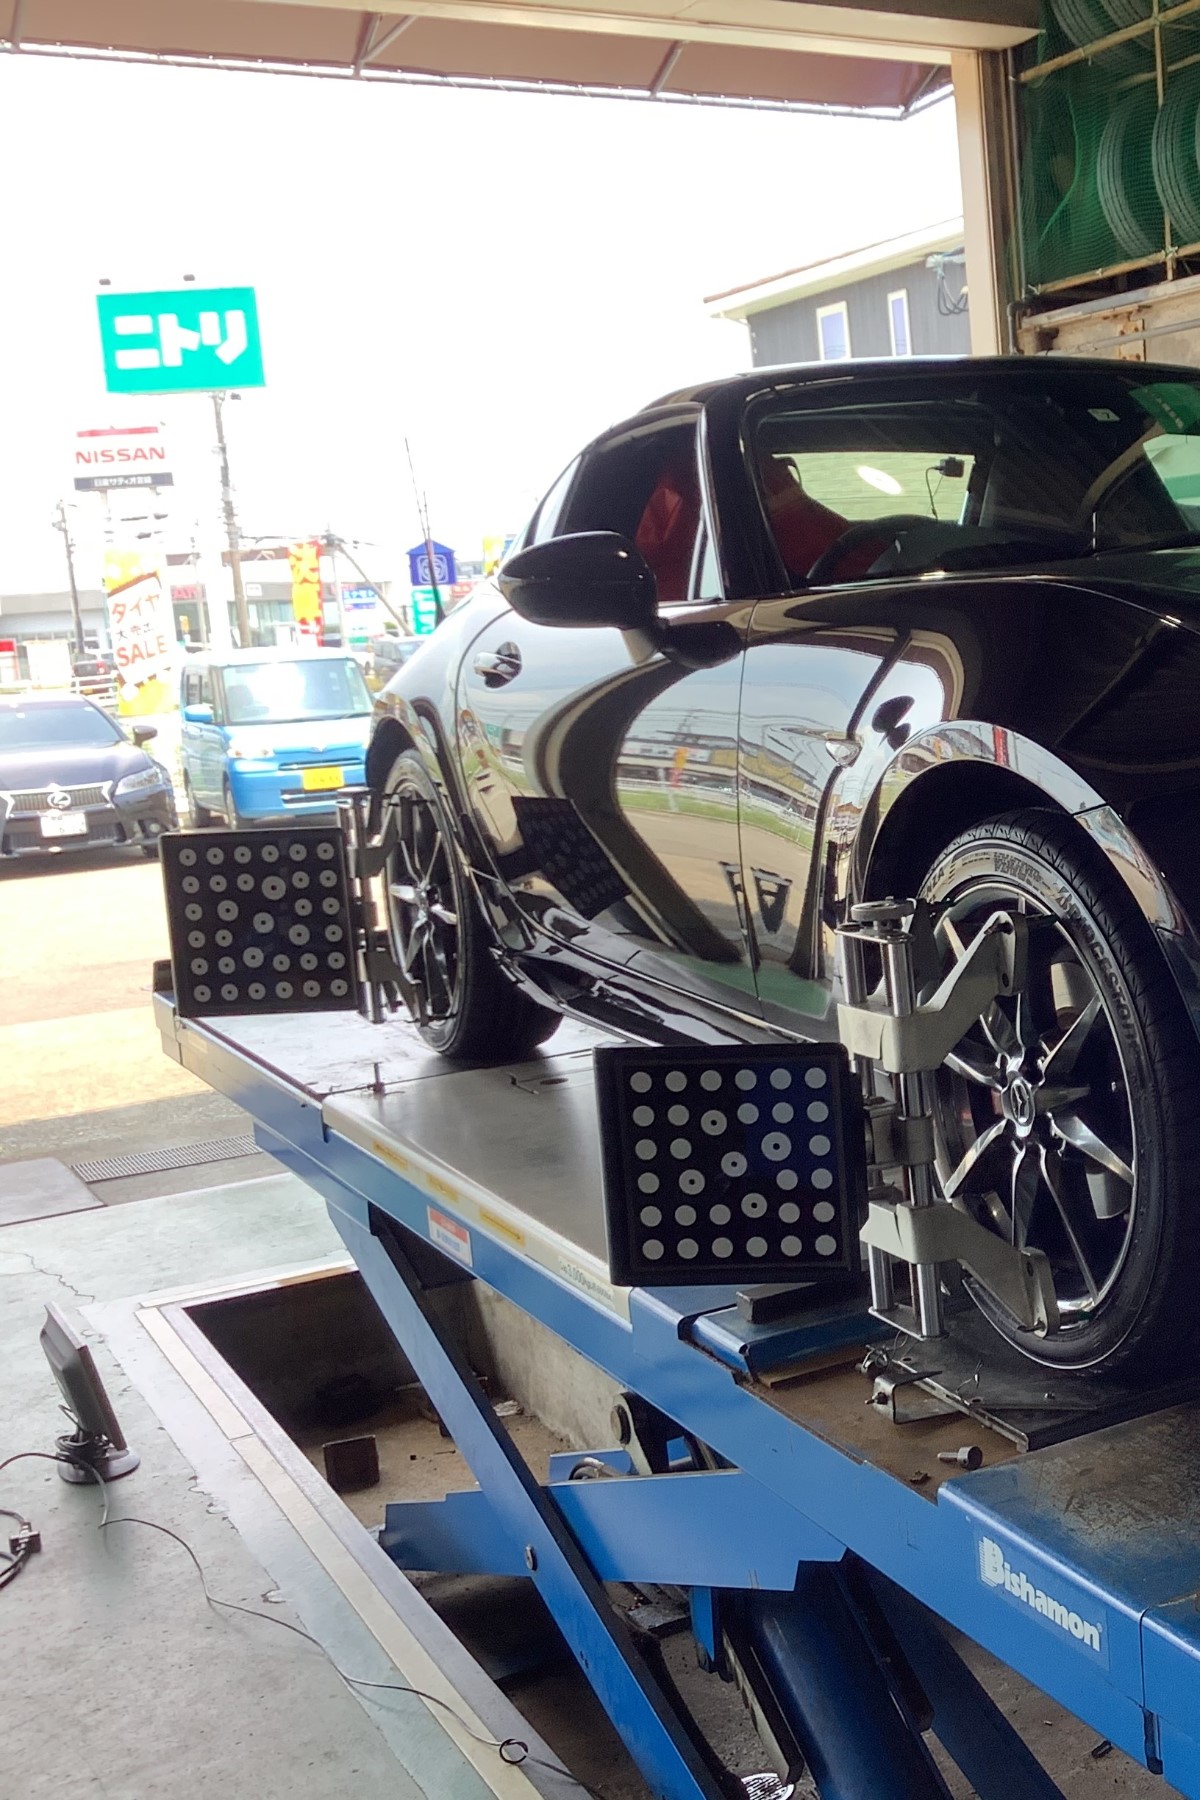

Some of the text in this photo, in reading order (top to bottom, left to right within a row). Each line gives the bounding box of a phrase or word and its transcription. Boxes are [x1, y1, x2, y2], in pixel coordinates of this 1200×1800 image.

[114, 309, 247, 370] ニトリ
[75, 447, 165, 464] NISSAN
[112, 594, 160, 624] タイヤ
[116, 635, 168, 667] SALE
[979, 1536, 1100, 1653] Bishamon
